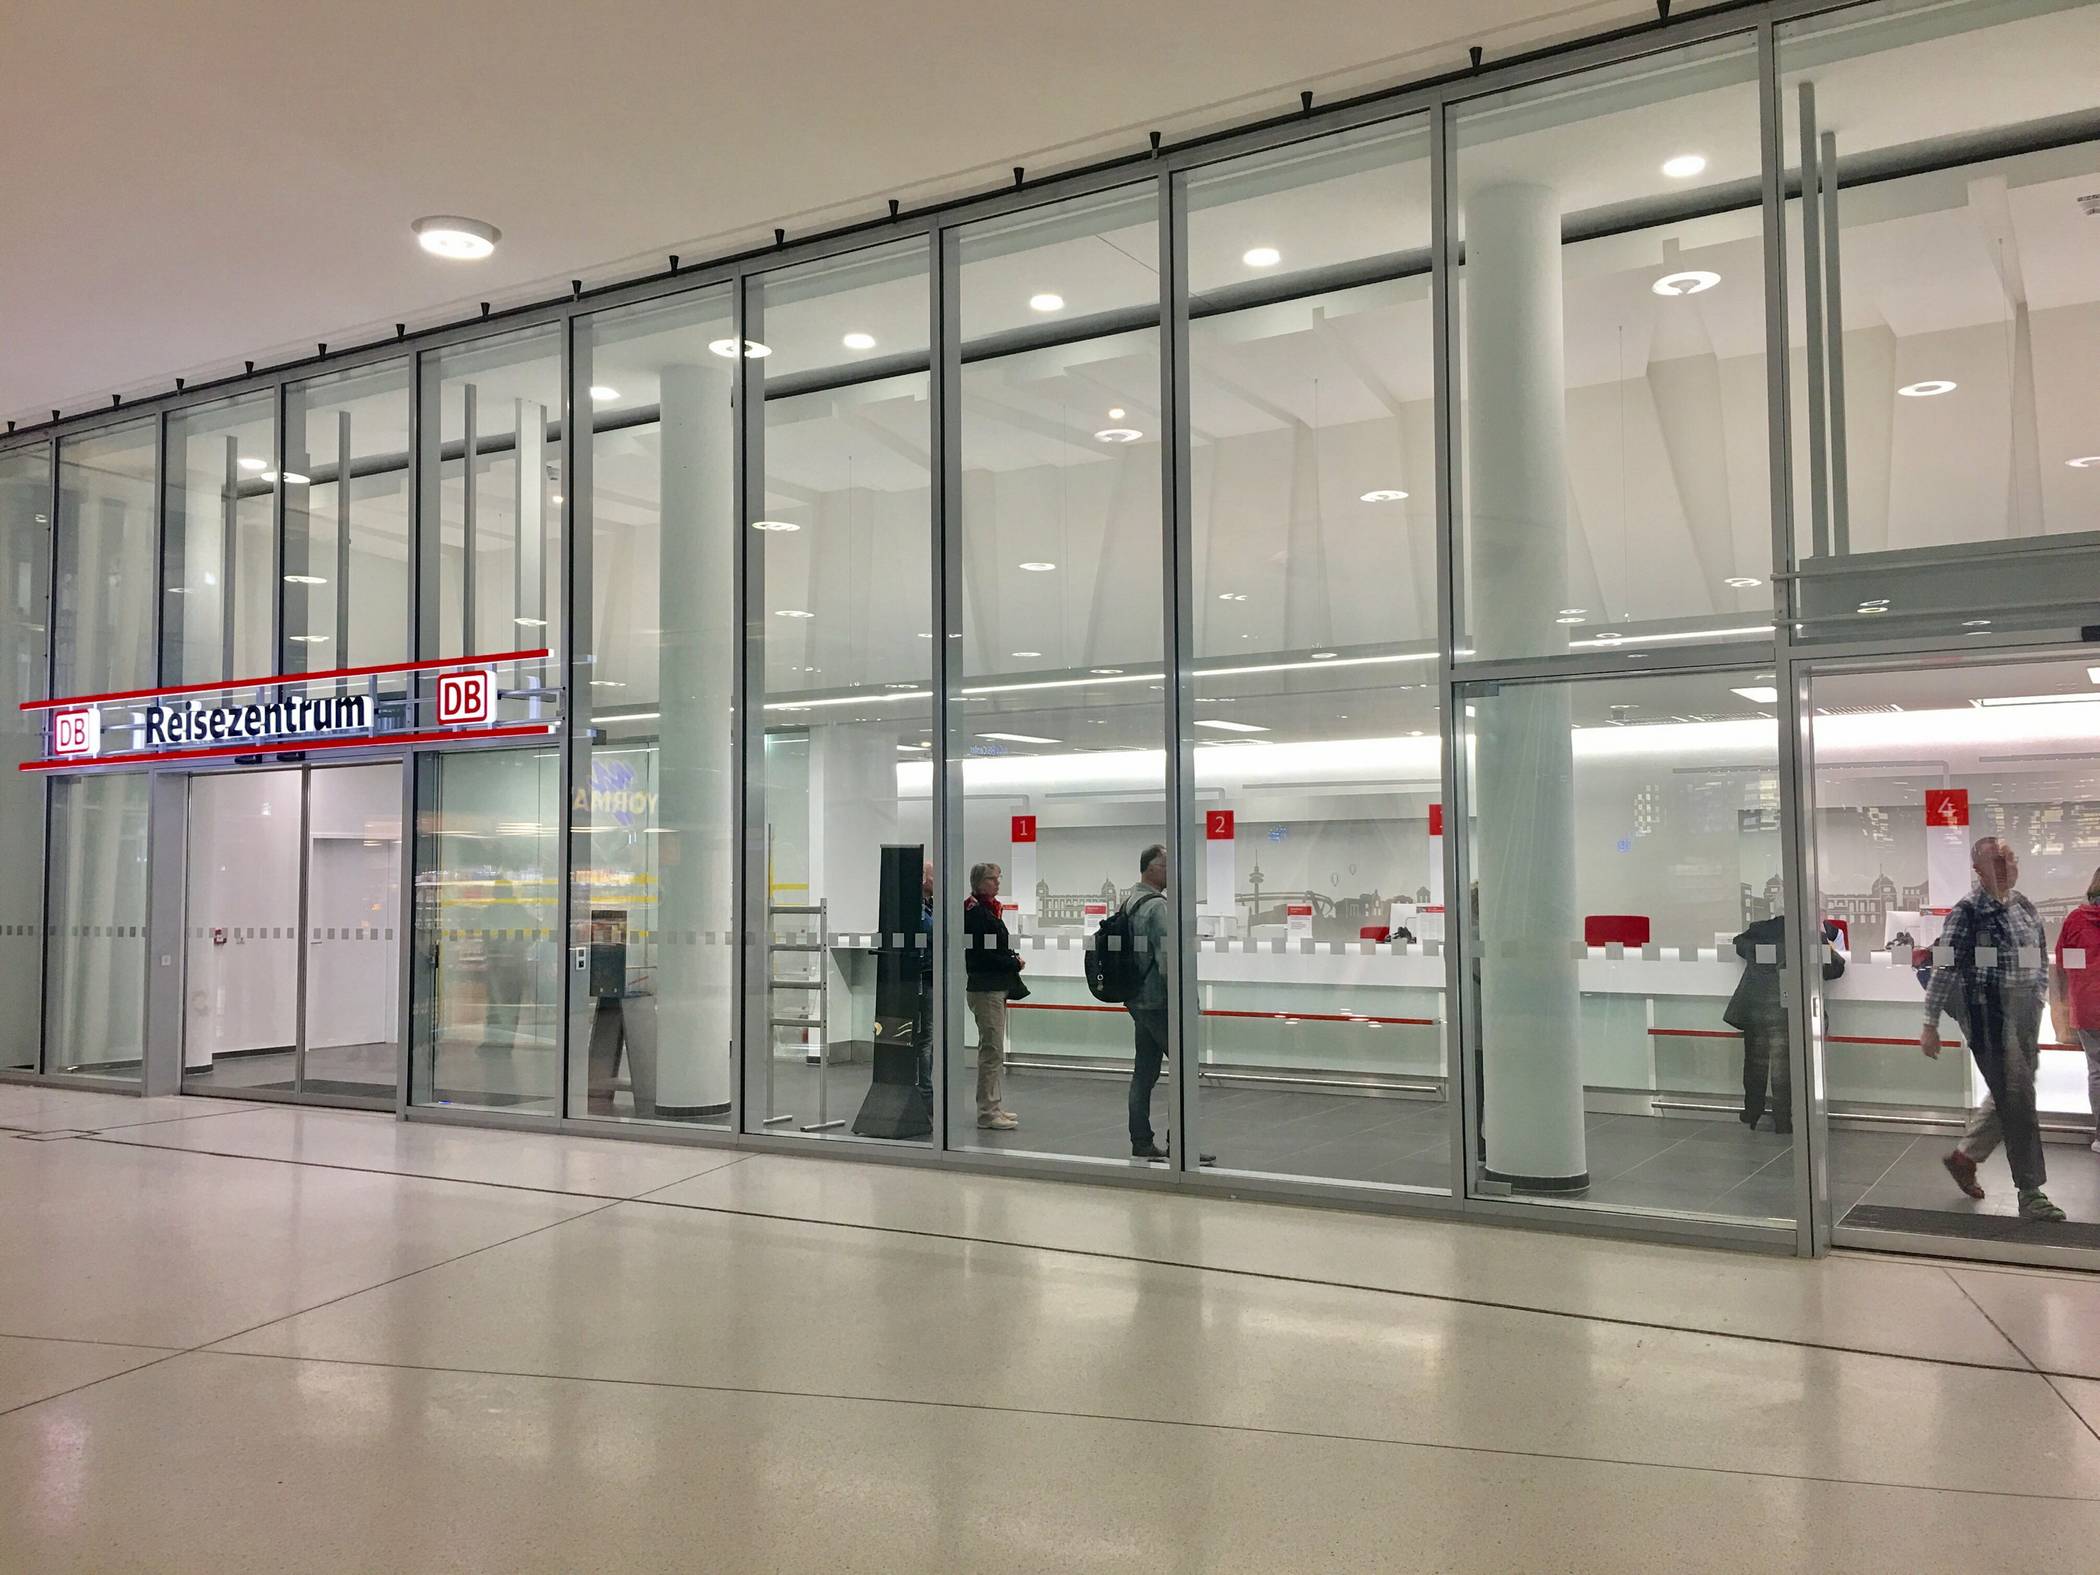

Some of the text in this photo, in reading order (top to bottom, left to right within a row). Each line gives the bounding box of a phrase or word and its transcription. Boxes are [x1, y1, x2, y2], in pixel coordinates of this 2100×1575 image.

[444, 680, 482, 715] DB
[60, 718, 86, 746] DB
[146, 695, 365, 744] Reisezentrum
[1937, 797, 1957, 819] 4
[1019, 819, 1028, 836] 1
[1215, 815, 1225, 833] 2
